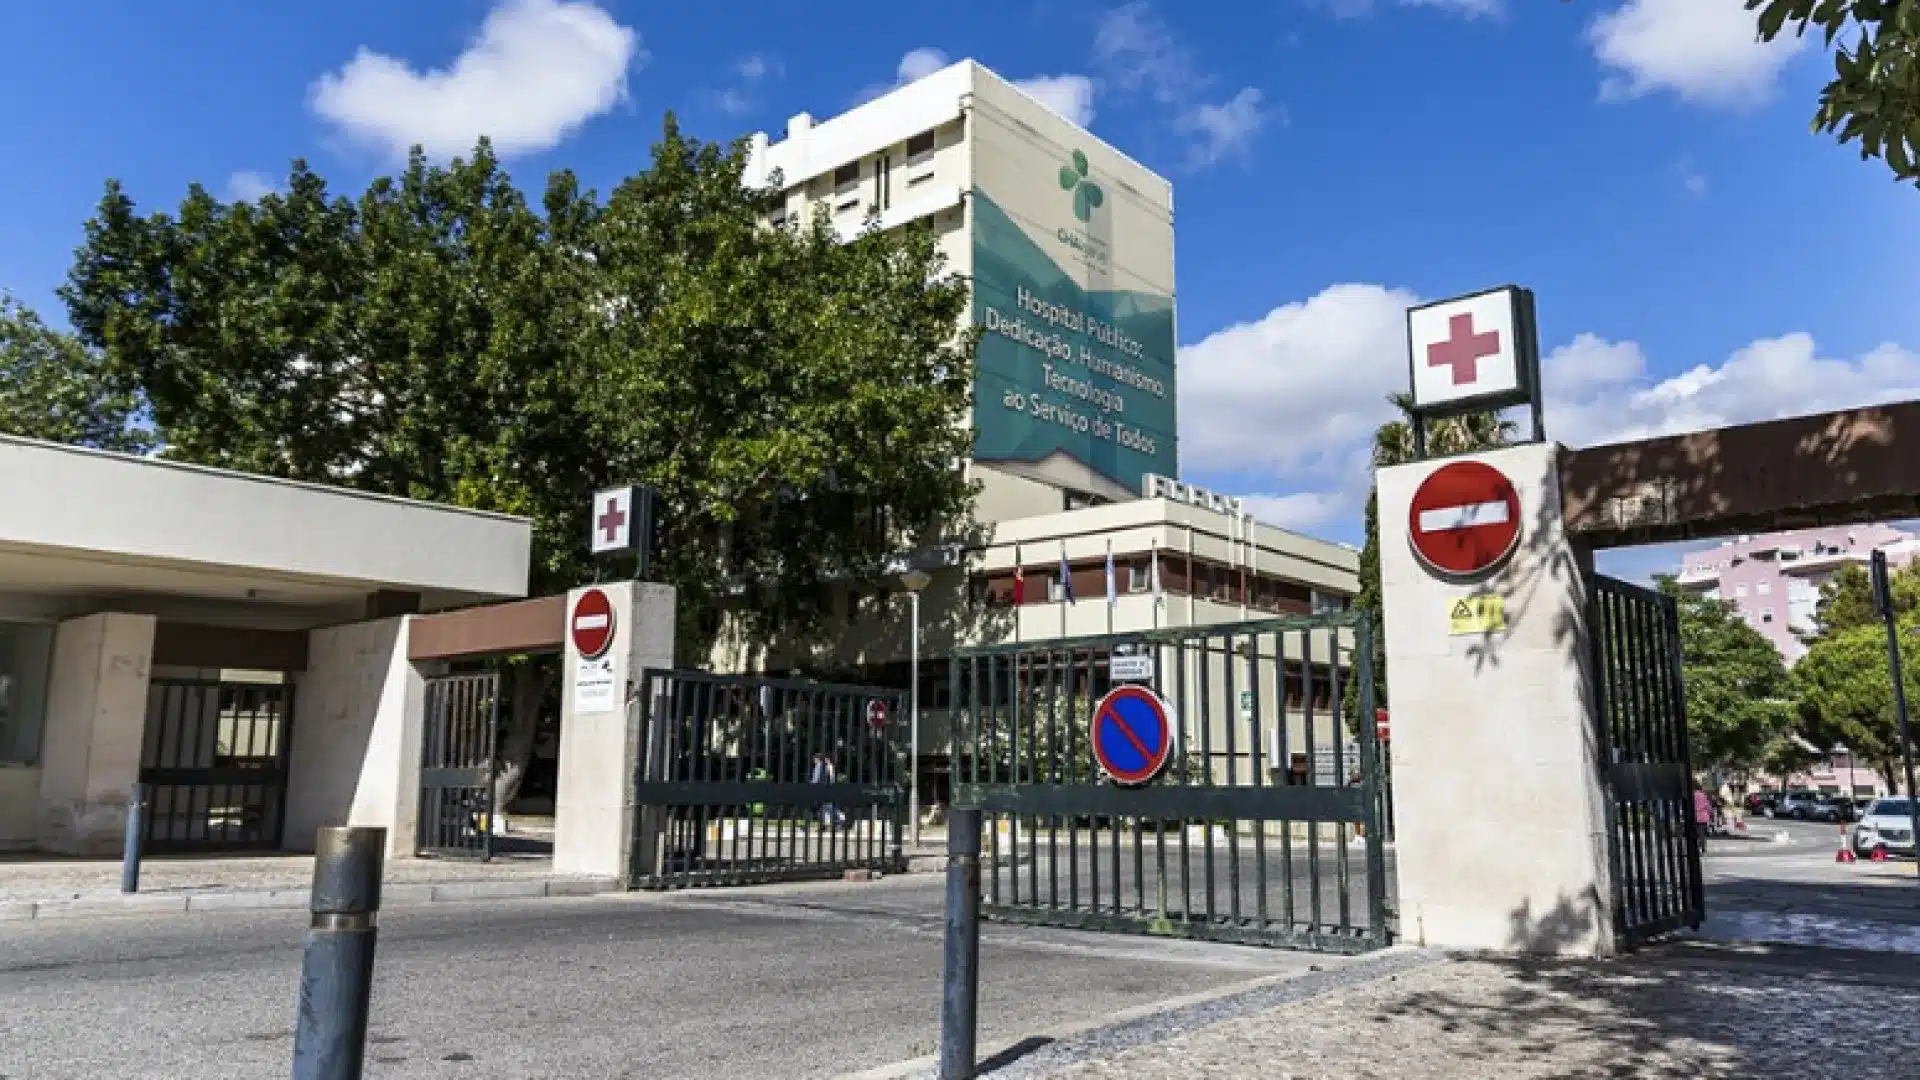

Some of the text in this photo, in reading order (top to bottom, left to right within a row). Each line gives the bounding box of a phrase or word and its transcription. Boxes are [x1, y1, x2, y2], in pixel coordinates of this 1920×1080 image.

[1017, 284, 1143, 360] Hospital Público:
[1043, 360, 1124, 413] Tecnologia
[1003, 388, 1156, 454] ao Serviço de Todos
